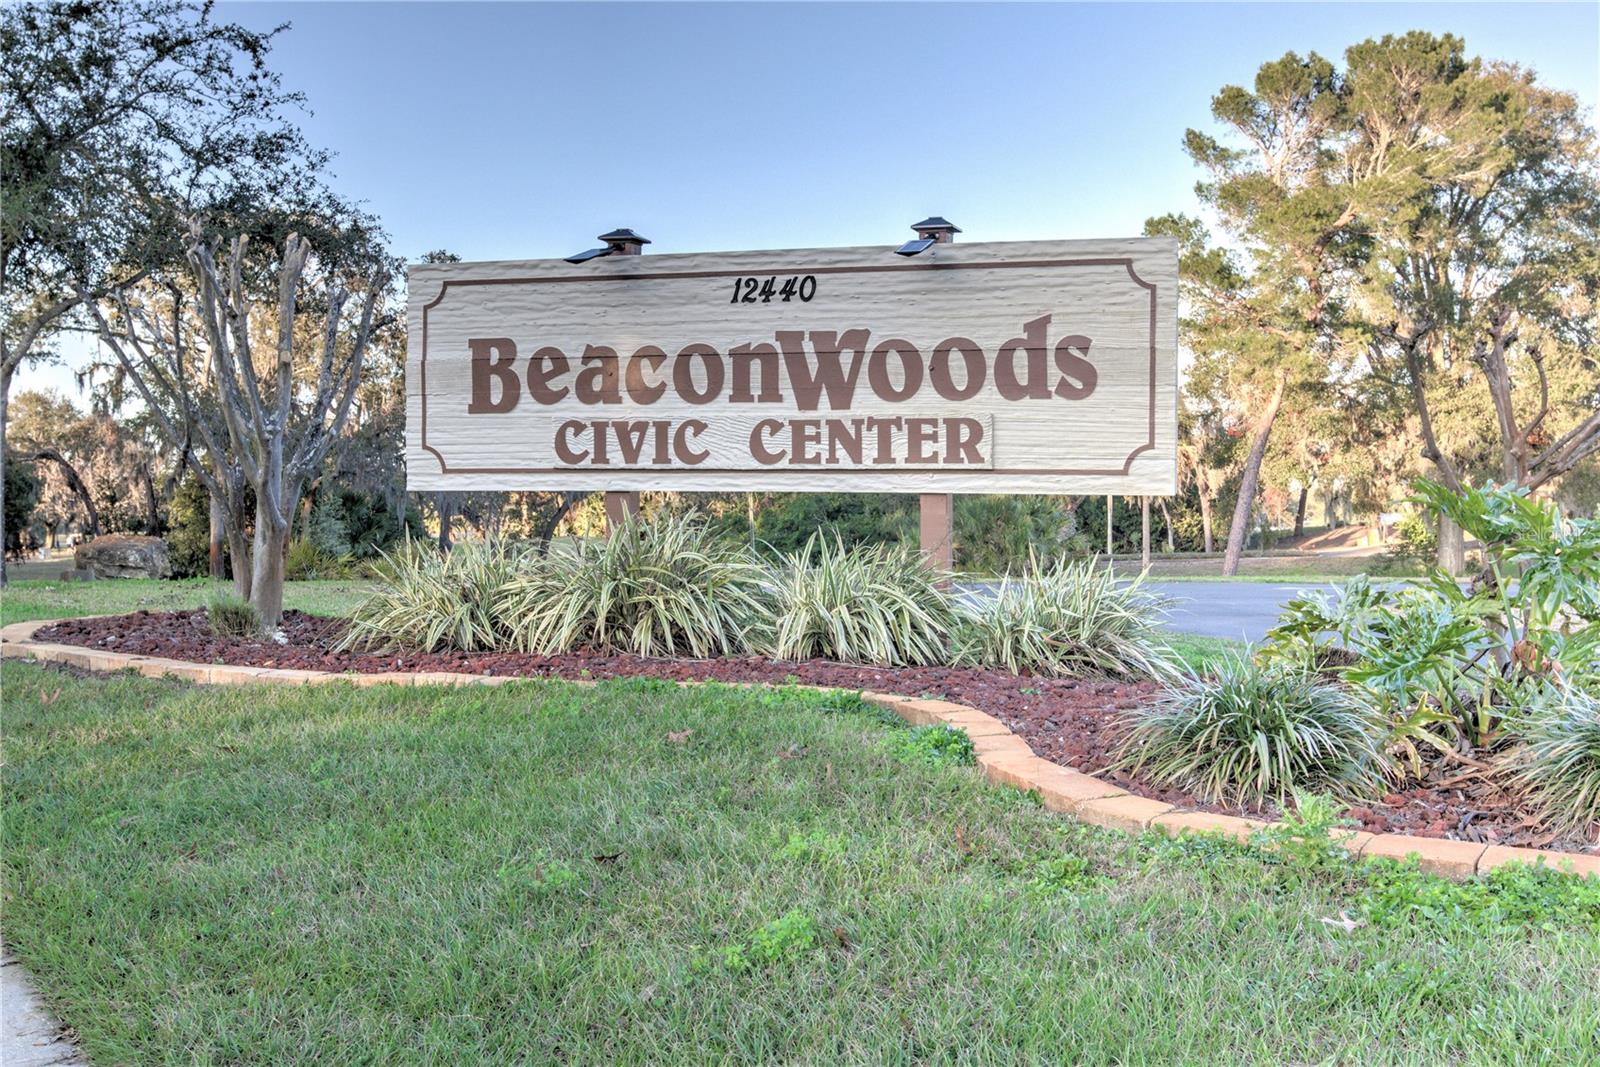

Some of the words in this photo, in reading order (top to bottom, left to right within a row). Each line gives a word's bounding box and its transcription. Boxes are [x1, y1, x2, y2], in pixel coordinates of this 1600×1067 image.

[730, 274, 818, 304] 12440
[468, 314, 1098, 415] BeaconWoods
[554, 419, 709, 465] CIVIC
[750, 416, 985, 465] CENTER
